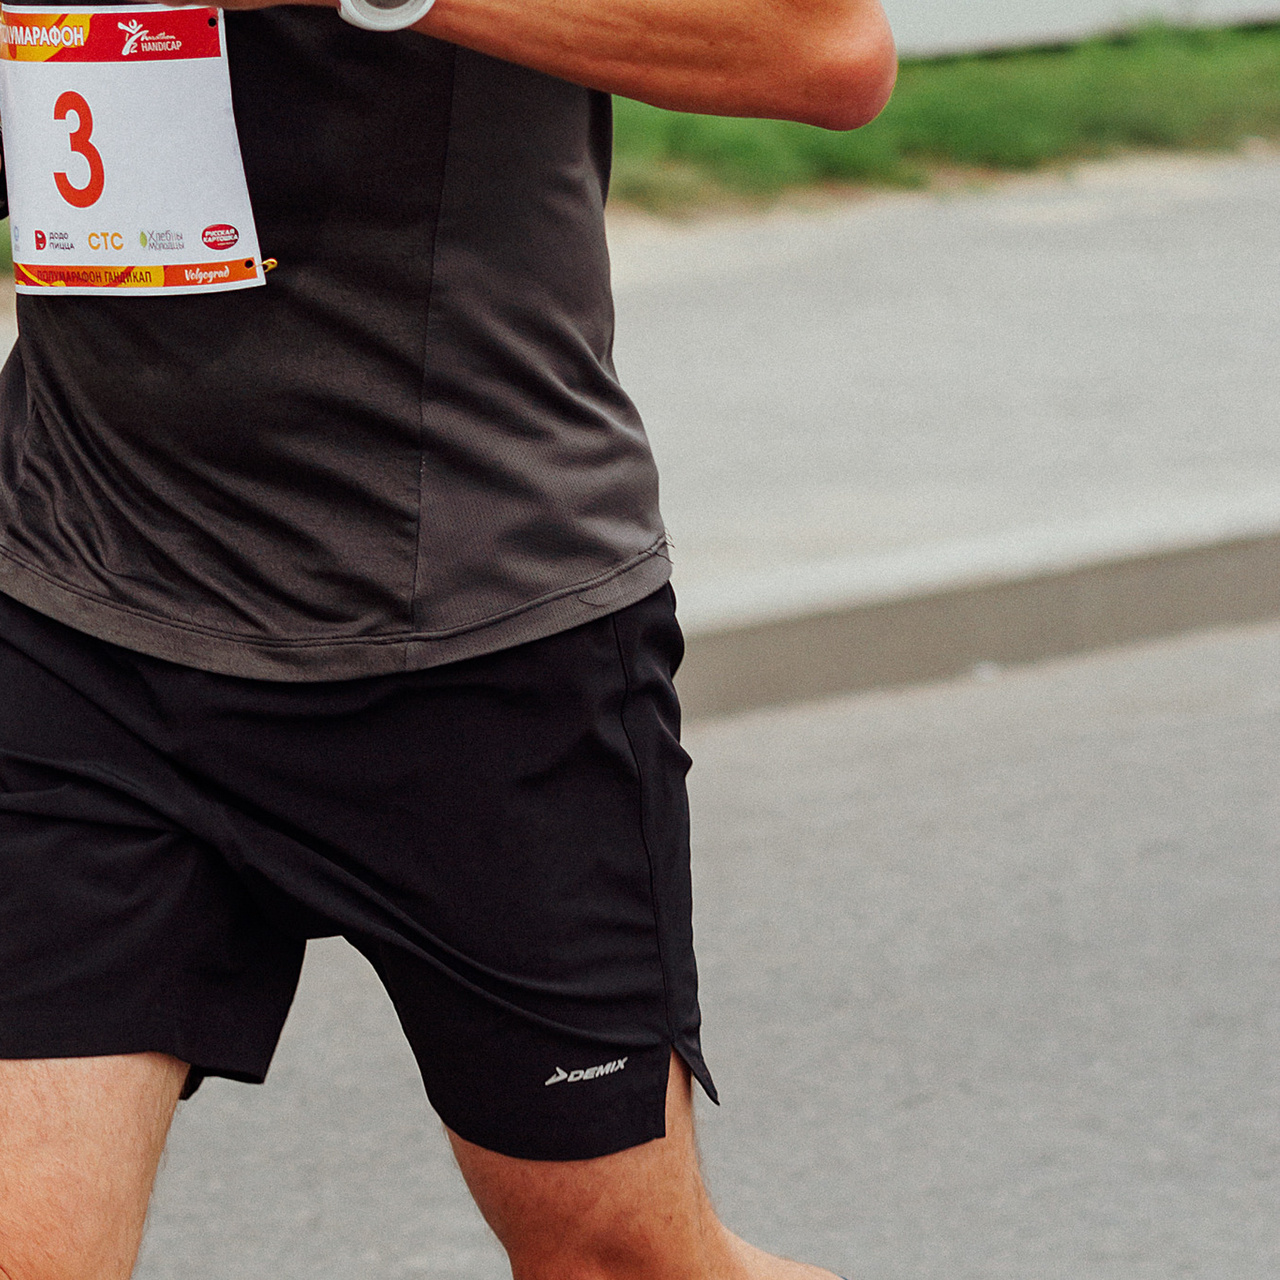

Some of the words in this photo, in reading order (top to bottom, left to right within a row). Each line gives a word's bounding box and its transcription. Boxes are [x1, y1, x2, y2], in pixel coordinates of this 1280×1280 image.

[141, 40, 182, 52] HANDICAP
[53, 90, 105, 209] 3
[49, 242, 75, 250] ПИЦЦА
[104, 271, 152, 284] ГАНДИКАП
[184, 265, 230, 284] Volgograd
[567, 1056, 628, 1083] DEMIX
